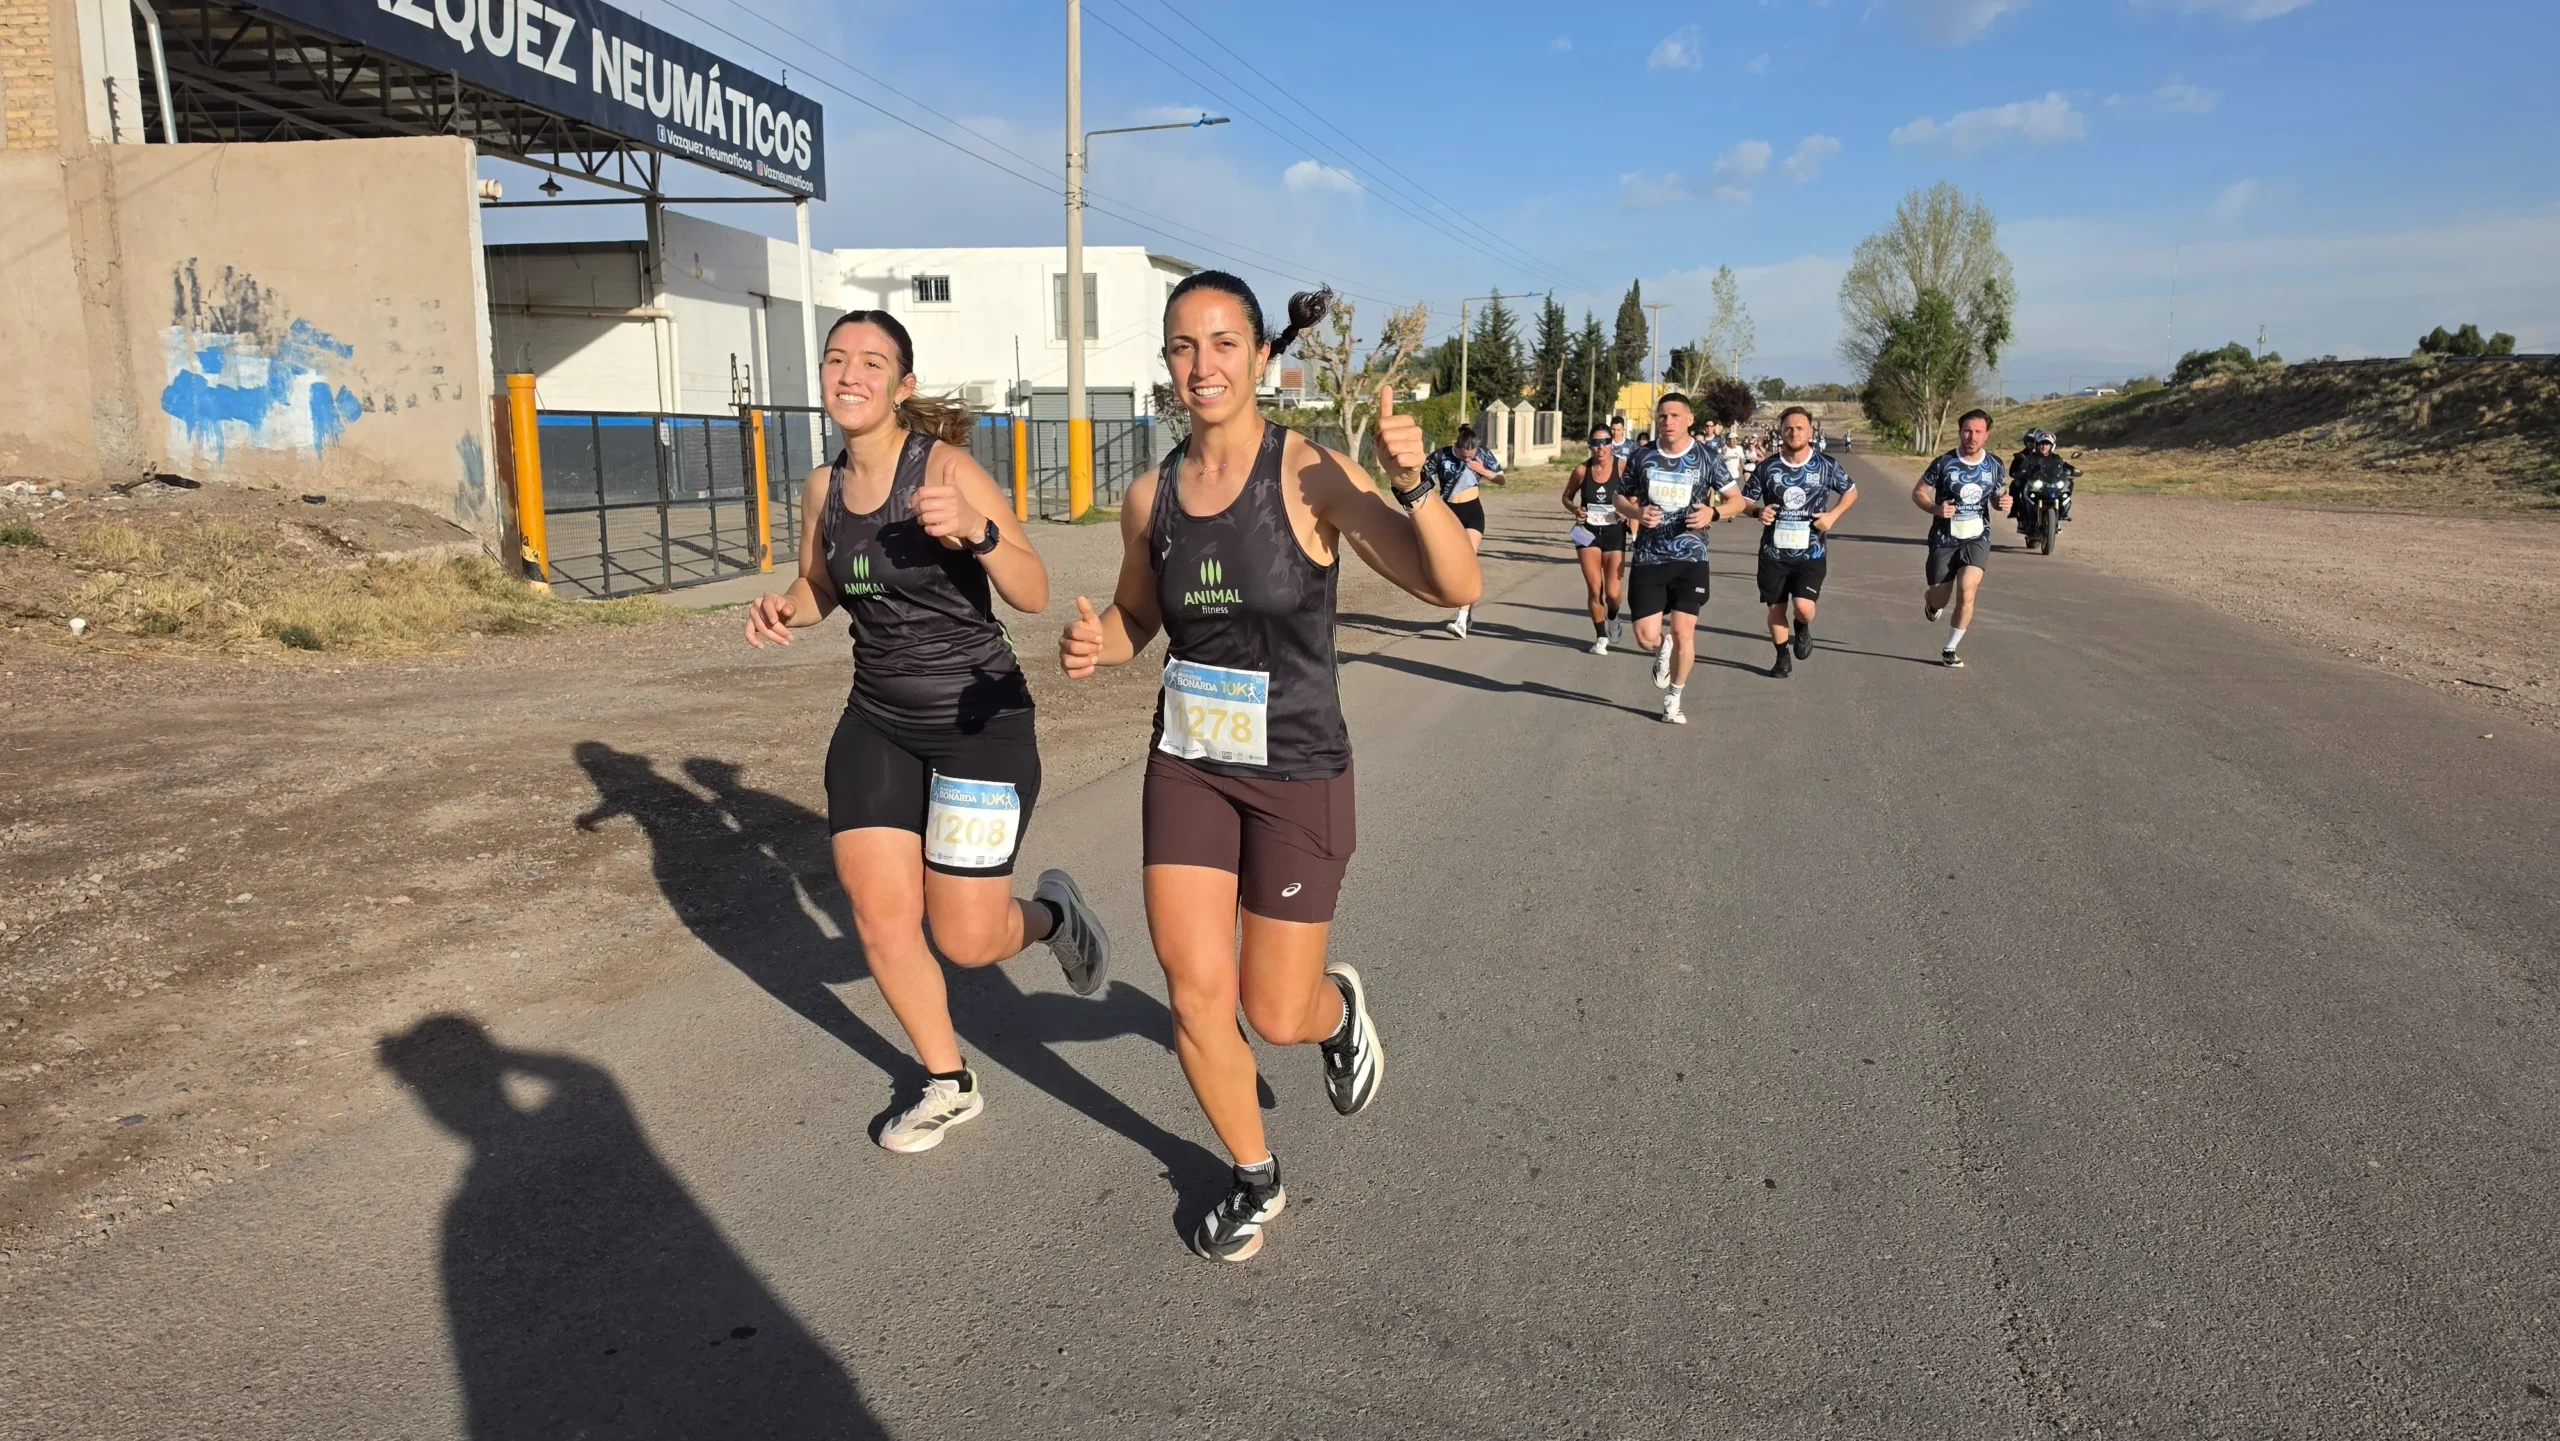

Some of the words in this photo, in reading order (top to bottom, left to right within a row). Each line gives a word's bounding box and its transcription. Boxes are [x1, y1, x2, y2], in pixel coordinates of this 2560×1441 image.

[377, 0, 577, 84] QUEZ
[592, 27, 812, 171] NEUMÁTICOS
[667, 129, 704, 155] Vazquez
[705, 145, 753, 172] neumaticos
[763, 163, 814, 193] Vazneumaticos
[1654, 484, 1686, 499] 1083
[844, 583, 890, 595] ANIMAL
[1184, 588, 1243, 605] ANIMAL
[1202, 605, 1229, 614] fitness
[1177, 678, 1218, 692] BONARDA
[1222, 681, 1248, 696] 10K
[1174, 701, 1252, 743] 1278
[939, 790, 977, 803] BONARDA
[981, 792, 1005, 805] 10K
[933, 812, 1006, 846] 1208
